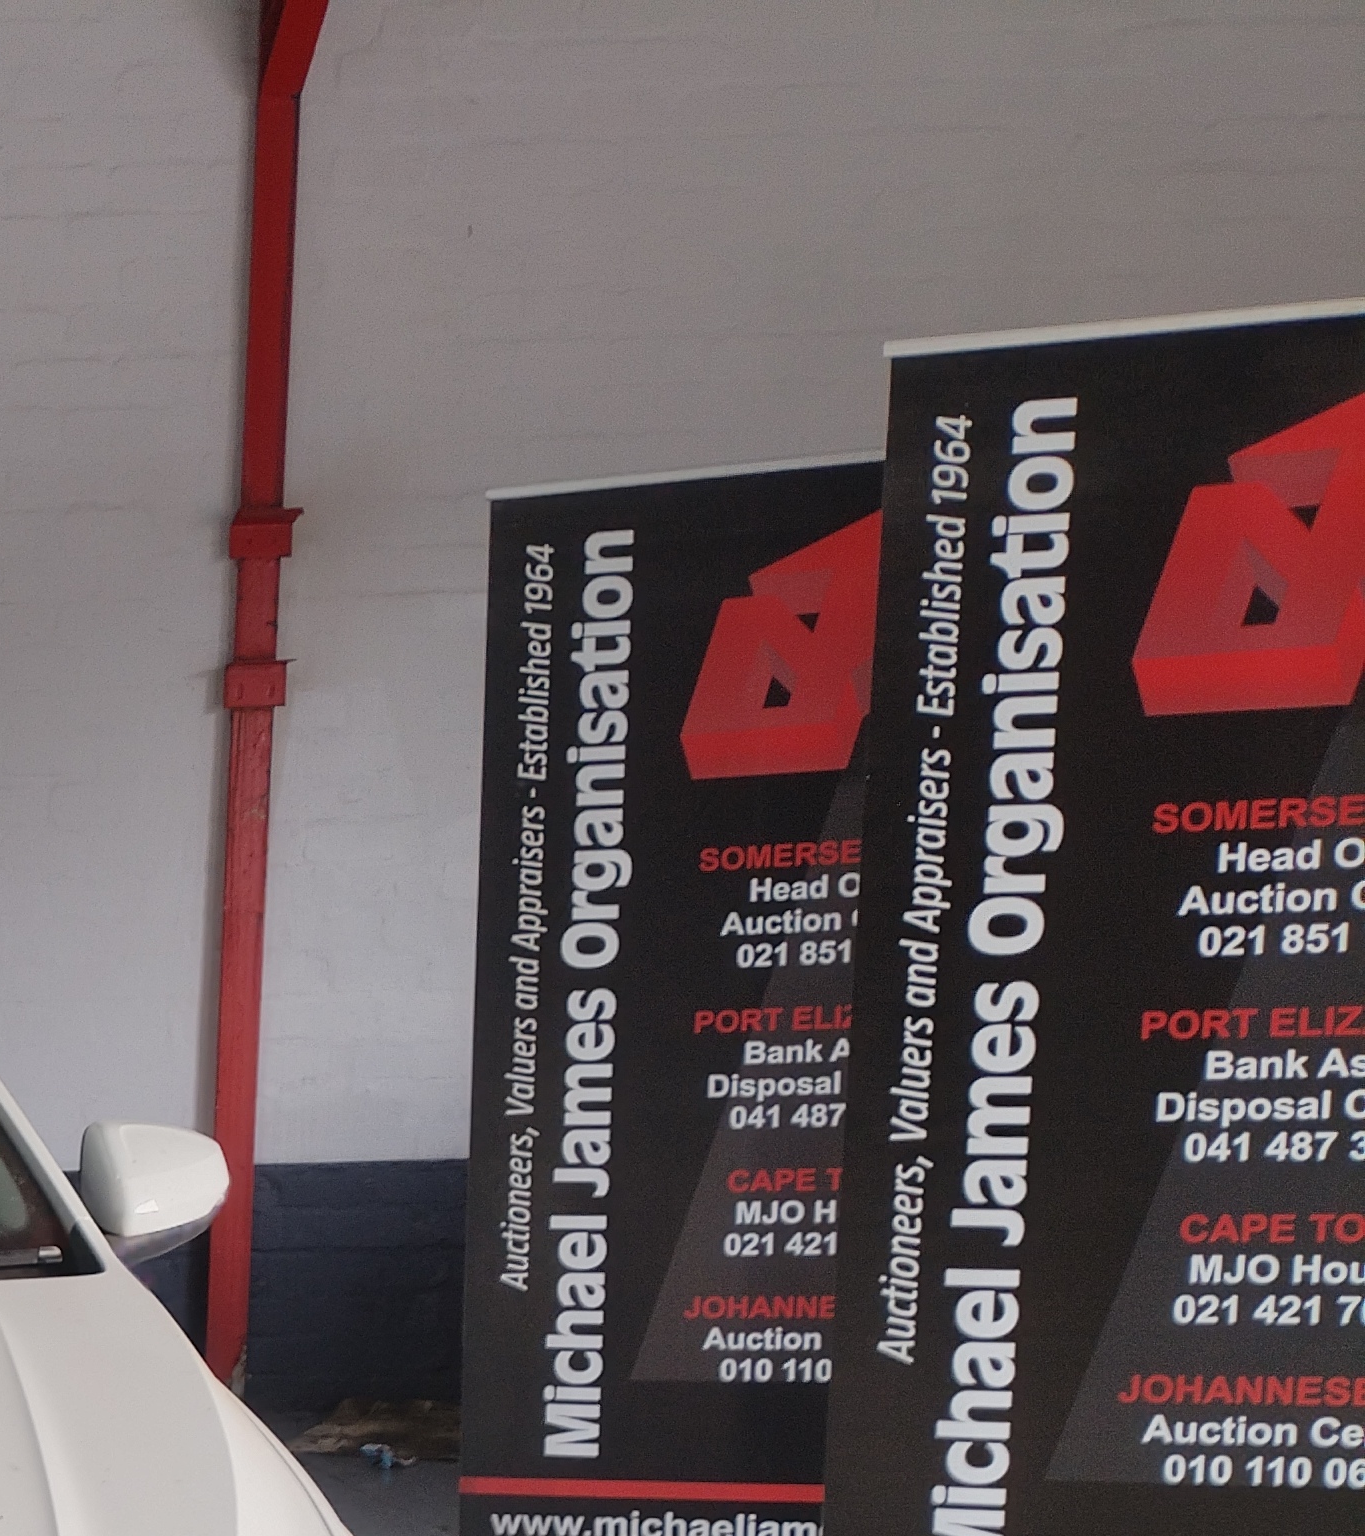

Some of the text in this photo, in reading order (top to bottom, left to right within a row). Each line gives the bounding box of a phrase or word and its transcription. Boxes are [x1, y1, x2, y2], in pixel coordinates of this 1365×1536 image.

[968, 397, 1078, 955] Organisation
[1153, 794, 1365, 833] SOMERSE
[699, 839, 861, 871] SOMERSE
[1218, 839, 1322, 873] Head
[750, 874, 829, 902] Head
[877, 415, 972, 1364] Auctioneers, Valuers and Appraisers Established 1964
[1178, 883, 1337, 916] Auction
[500, 544, 554, 1291] Auctioneers, Valuers and Appraisers Established 1964
[720, 908, 842, 936] Auction
[737, 939, 851, 968] 021 851
[1199, 922, 1349, 957] 021 851
[543, 530, 634, 1458] Michael James Organisation
[694, 1007, 784, 1033] PORT
[1141, 1008, 1259, 1040] PORT
[744, 1039, 822, 1065] Bank
[1205, 1049, 1304, 1080] Bank
[708, 1071, 841, 1102] Disposal
[729, 1103, 846, 1129] 041 487
[950, 981, 1039, 1246] James
[1156, 1090, 1332, 1128] Disposal
[1184, 1132, 1250, 1162] 041
[1264, 1131, 1338, 1161] 487
[727, 1168, 816, 1193] CAPE
[735, 1200, 805, 1225] MJO
[1180, 1213, 1296, 1243] CAPE
[724, 1232, 837, 1256] 021 421
[1189, 1254, 1279, 1284] MJO
[683, 1295, 835, 1320] JOHANNE
[1173, 1295, 1238, 1324] 021
[1253, 1295, 1321, 1325] 421
[702, 1327, 821, 1351] Auction
[719, 1358, 832, 1382] 010 110
[1142, 1414, 1297, 1446] Auction
[1163, 1454, 1232, 1485] 010
[1246, 1456, 1312, 1487] 110
